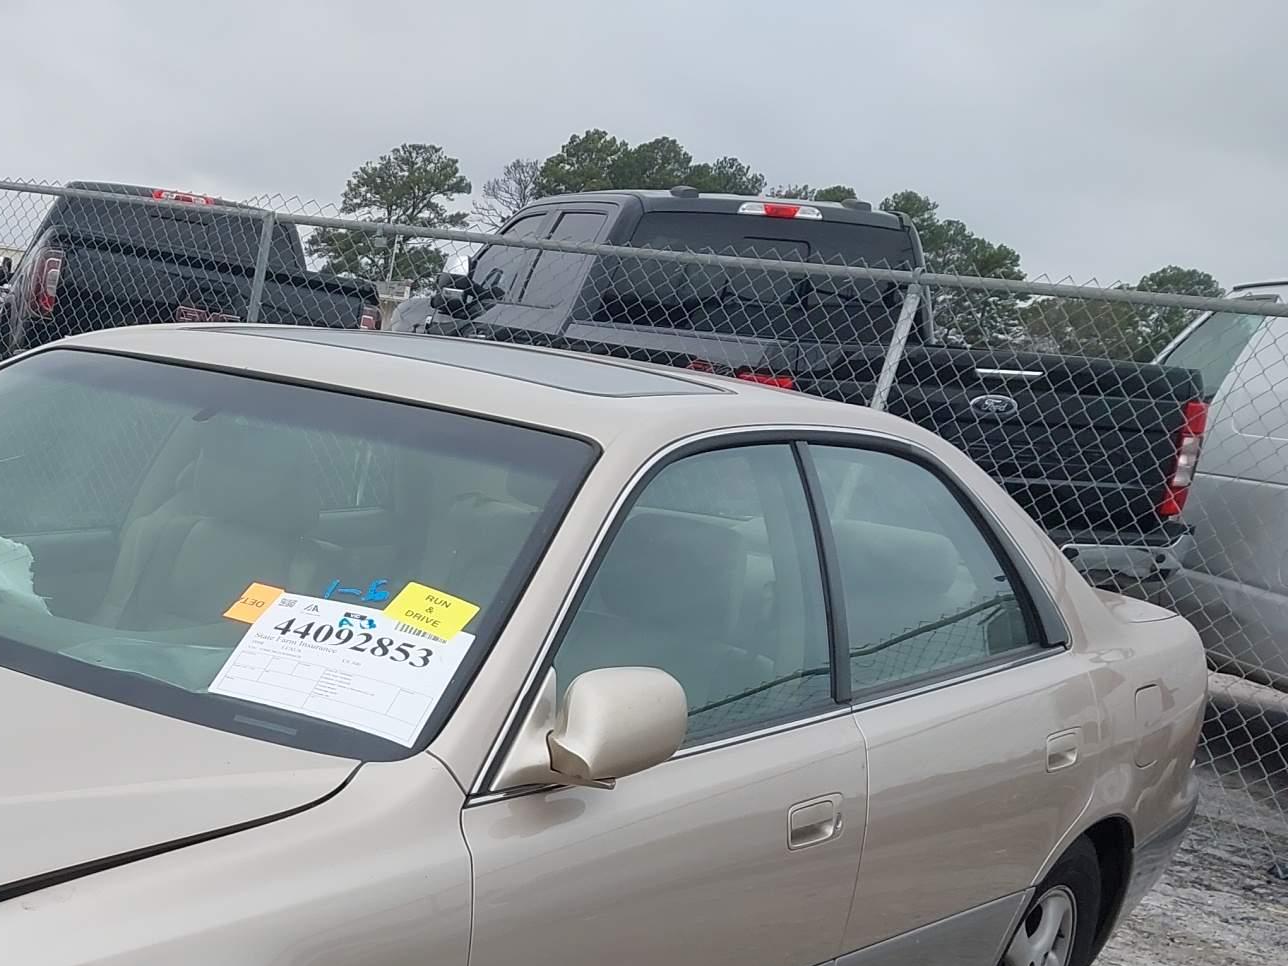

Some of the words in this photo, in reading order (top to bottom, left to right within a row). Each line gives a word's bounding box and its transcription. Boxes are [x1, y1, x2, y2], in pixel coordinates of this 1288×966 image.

[981, 399, 1008, 412] Ford
[424, 593, 452, 609] RUN
[404, 609, 441, 628] DRIVE
[425, 606, 434, 614] &
[255, 632, 276, 643] State
[277, 635, 297, 647] Farm
[299, 640, 338, 654] Insurance
[274, 617, 434, 668] 44092853
